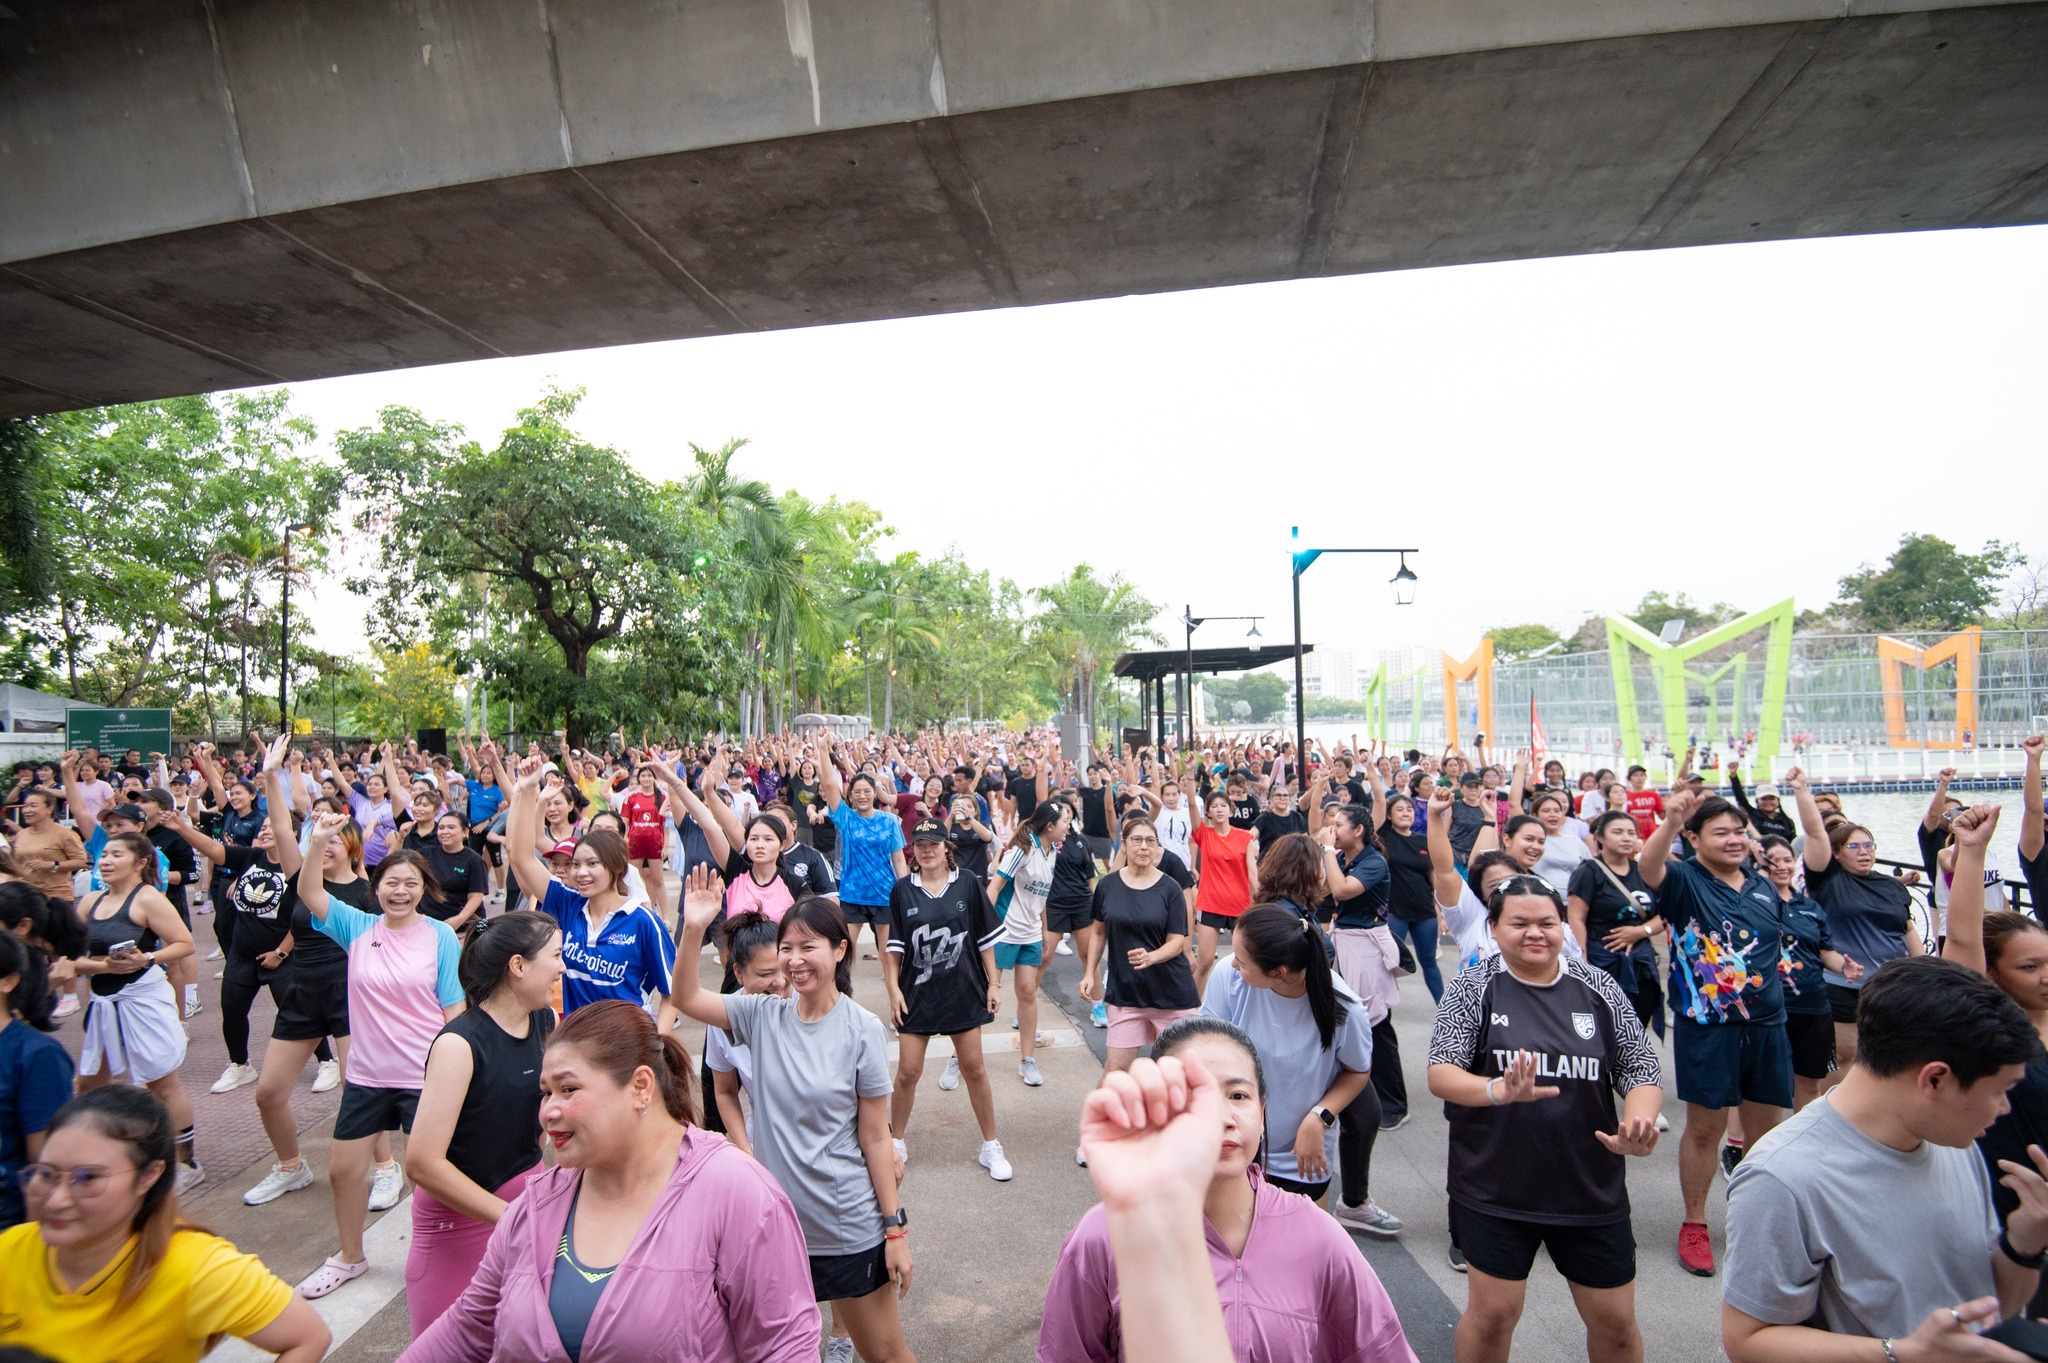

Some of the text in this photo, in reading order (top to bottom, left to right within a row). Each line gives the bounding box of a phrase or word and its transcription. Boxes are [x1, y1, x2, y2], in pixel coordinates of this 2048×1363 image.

[271, 874, 282, 890] WITH
[1984, 869, 1999, 881] IKE
[271, 890, 282, 905] THE
